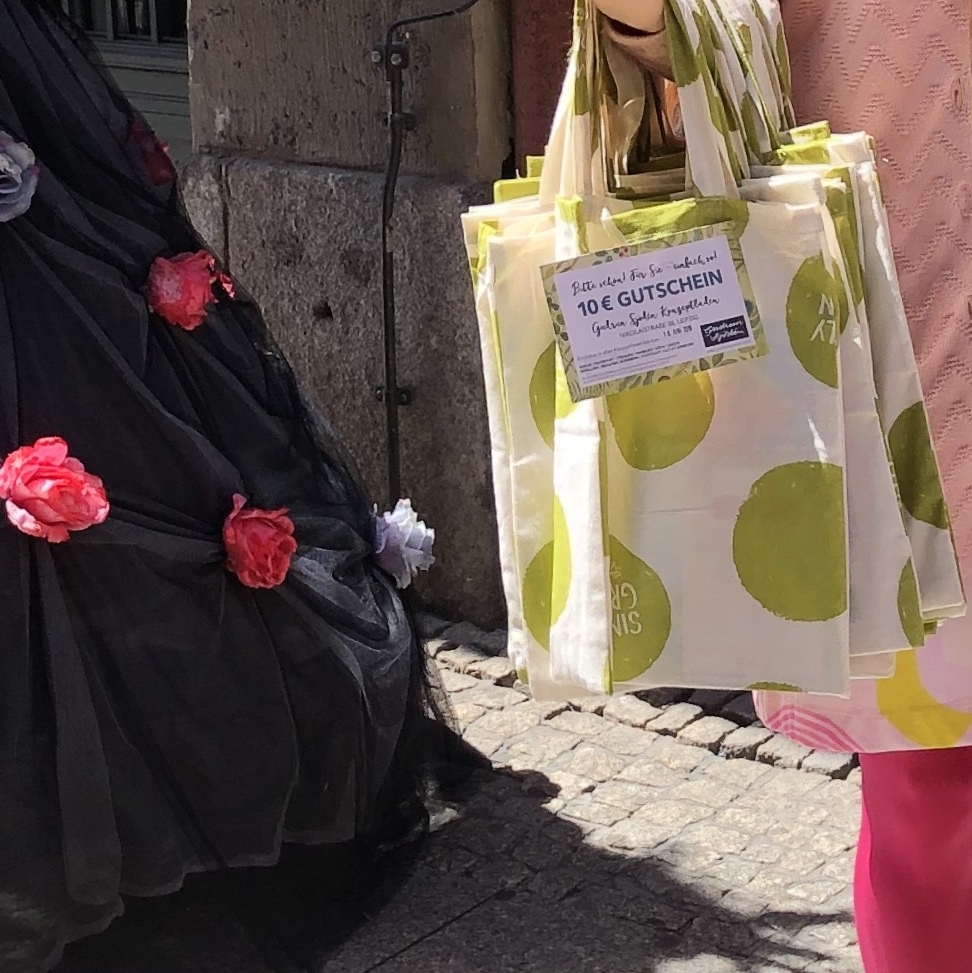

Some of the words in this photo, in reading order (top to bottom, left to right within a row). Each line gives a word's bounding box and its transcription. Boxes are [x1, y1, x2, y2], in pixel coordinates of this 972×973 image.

[577, 299, 599, 317] 10
[601, 295, 614, 311] €
[617, 269, 723, 307] GUTSCHEIN
